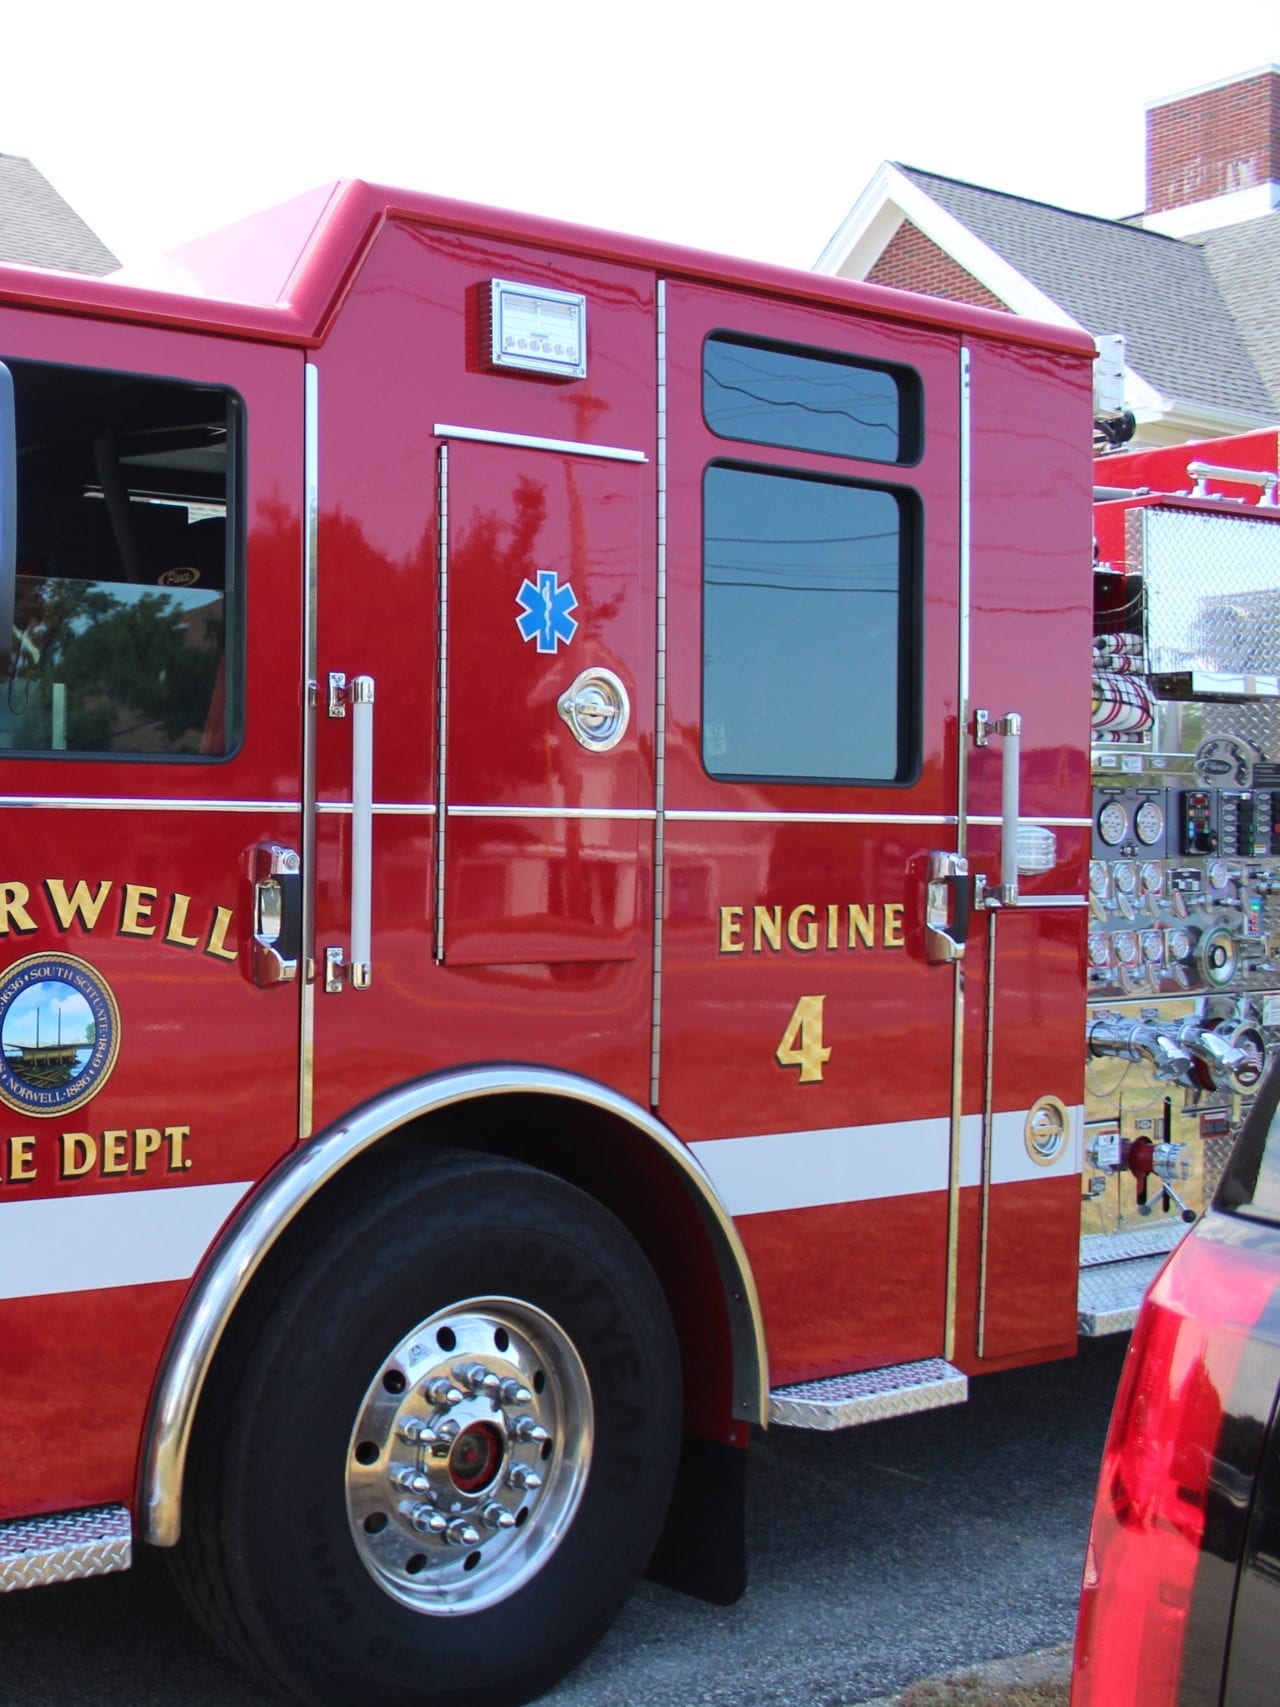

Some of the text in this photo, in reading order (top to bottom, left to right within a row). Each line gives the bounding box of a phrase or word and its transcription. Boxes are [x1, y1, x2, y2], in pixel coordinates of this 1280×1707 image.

[719, 903, 905, 955] ENGINE
[0, 977, 24, 1004] 1636
[29, 966, 73, 981] SOUTH
[73, 975, 109, 1034] SCITUATE
[775, 994, 832, 1085] 4
[6, 1077, 65, 1104] NORWELL
[60, 1124, 193, 1178] DEPT.
